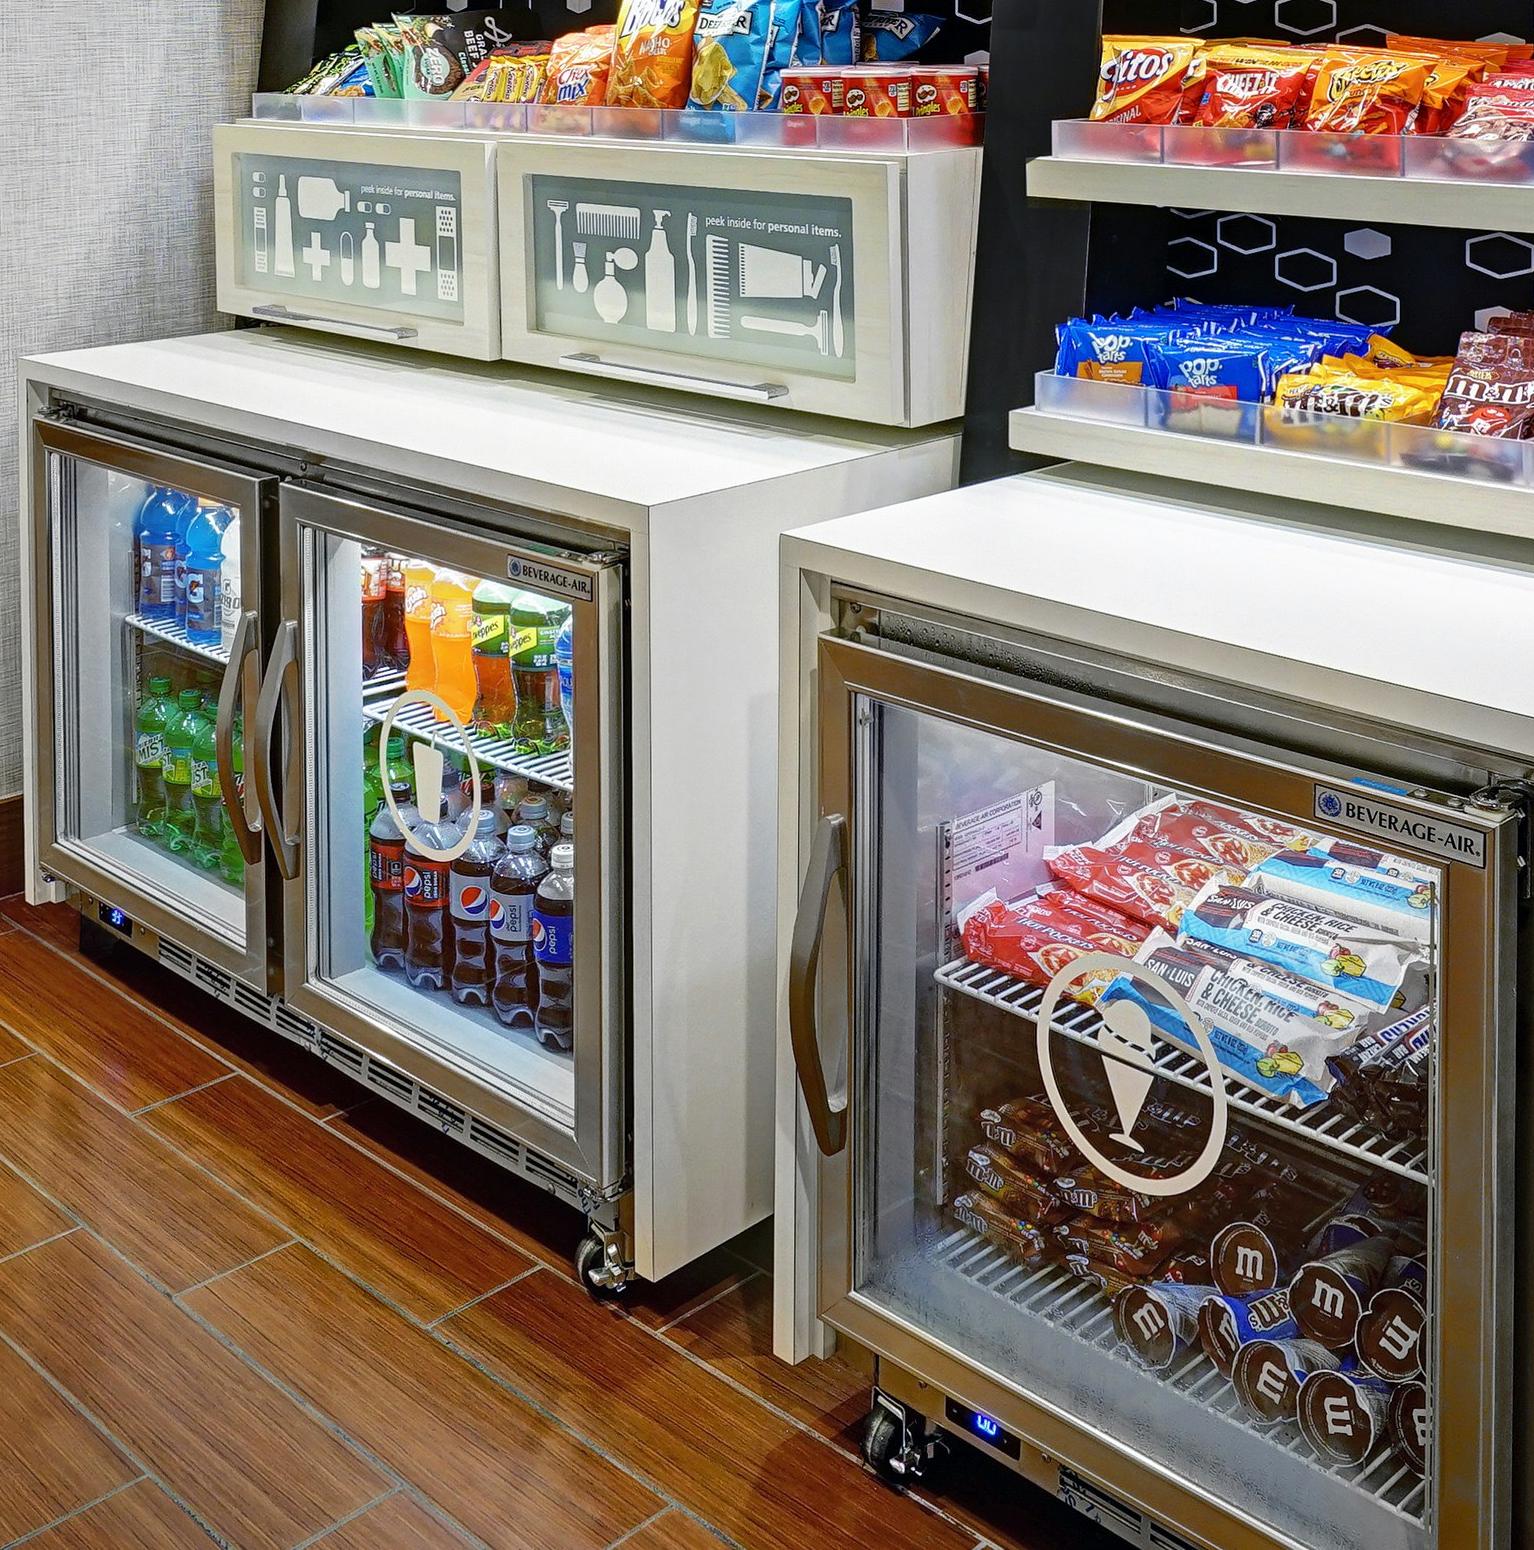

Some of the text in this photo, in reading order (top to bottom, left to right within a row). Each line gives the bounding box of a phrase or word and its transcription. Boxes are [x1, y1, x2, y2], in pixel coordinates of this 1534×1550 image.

[463, 29, 480, 61] BEEF
[425, 47, 446, 87] ZERO
[558, 67, 589, 85] Chex
[558, 81, 588, 101] mix
[360, 185, 456, 202] peek inside for personal items.
[705, 216, 842, 238] peek inside for personal items.
[1097, 348, 1127, 364] tarts
[1188, 373, 1218, 388] tarts
[187, 572, 204, 604] G
[138, 738, 165, 762] MIST
[423, 871, 432, 899] pepsi
[509, 904, 517, 932] pepsi
[1018, 917, 1042, 932] HOT
[1272, 911, 1317, 932] CHEESE
[548, 925, 556, 955] pepsi
[1146, 959, 1195, 987] SAN LUIS
[1201, 984, 1280, 1037] & CHEESE BURRITO
[1235, 1245, 1263, 1281] m
[1311, 1278, 1344, 1319] m
[1132, 1301, 1166, 1341] m
[1255, 1360, 1289, 1405] m
[1323, 1395, 1355, 1438] m
